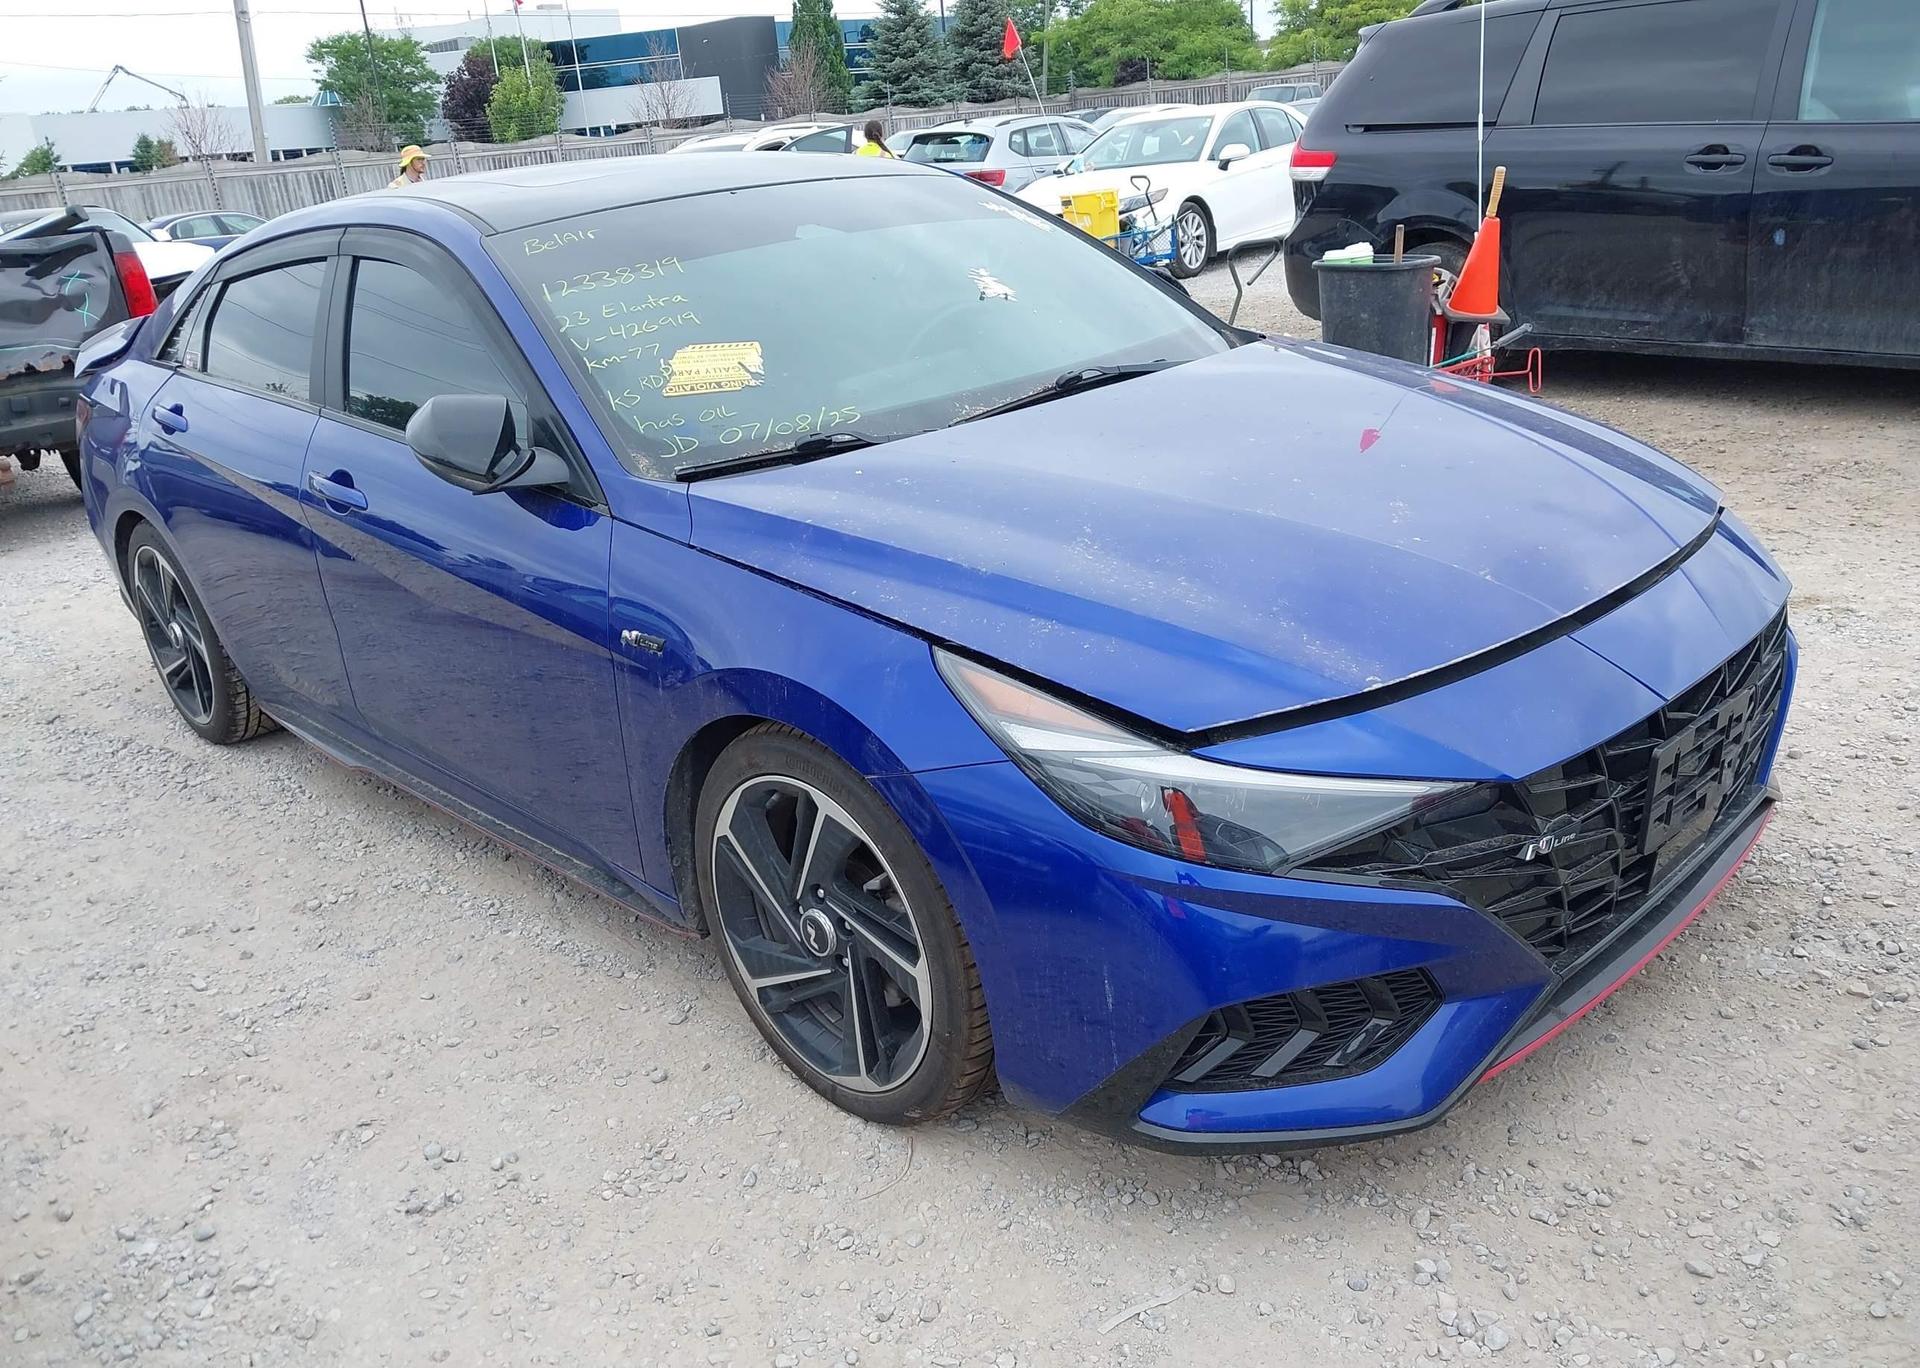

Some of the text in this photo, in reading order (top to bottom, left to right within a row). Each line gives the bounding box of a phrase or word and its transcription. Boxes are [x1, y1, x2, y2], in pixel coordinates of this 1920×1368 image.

[542, 256, 684, 302] 12338319
[555, 294, 688, 333] 23 Elantra
[664, 380, 720, 393] VIOLATIO
[719, 406, 861, 445] 07/08/25
